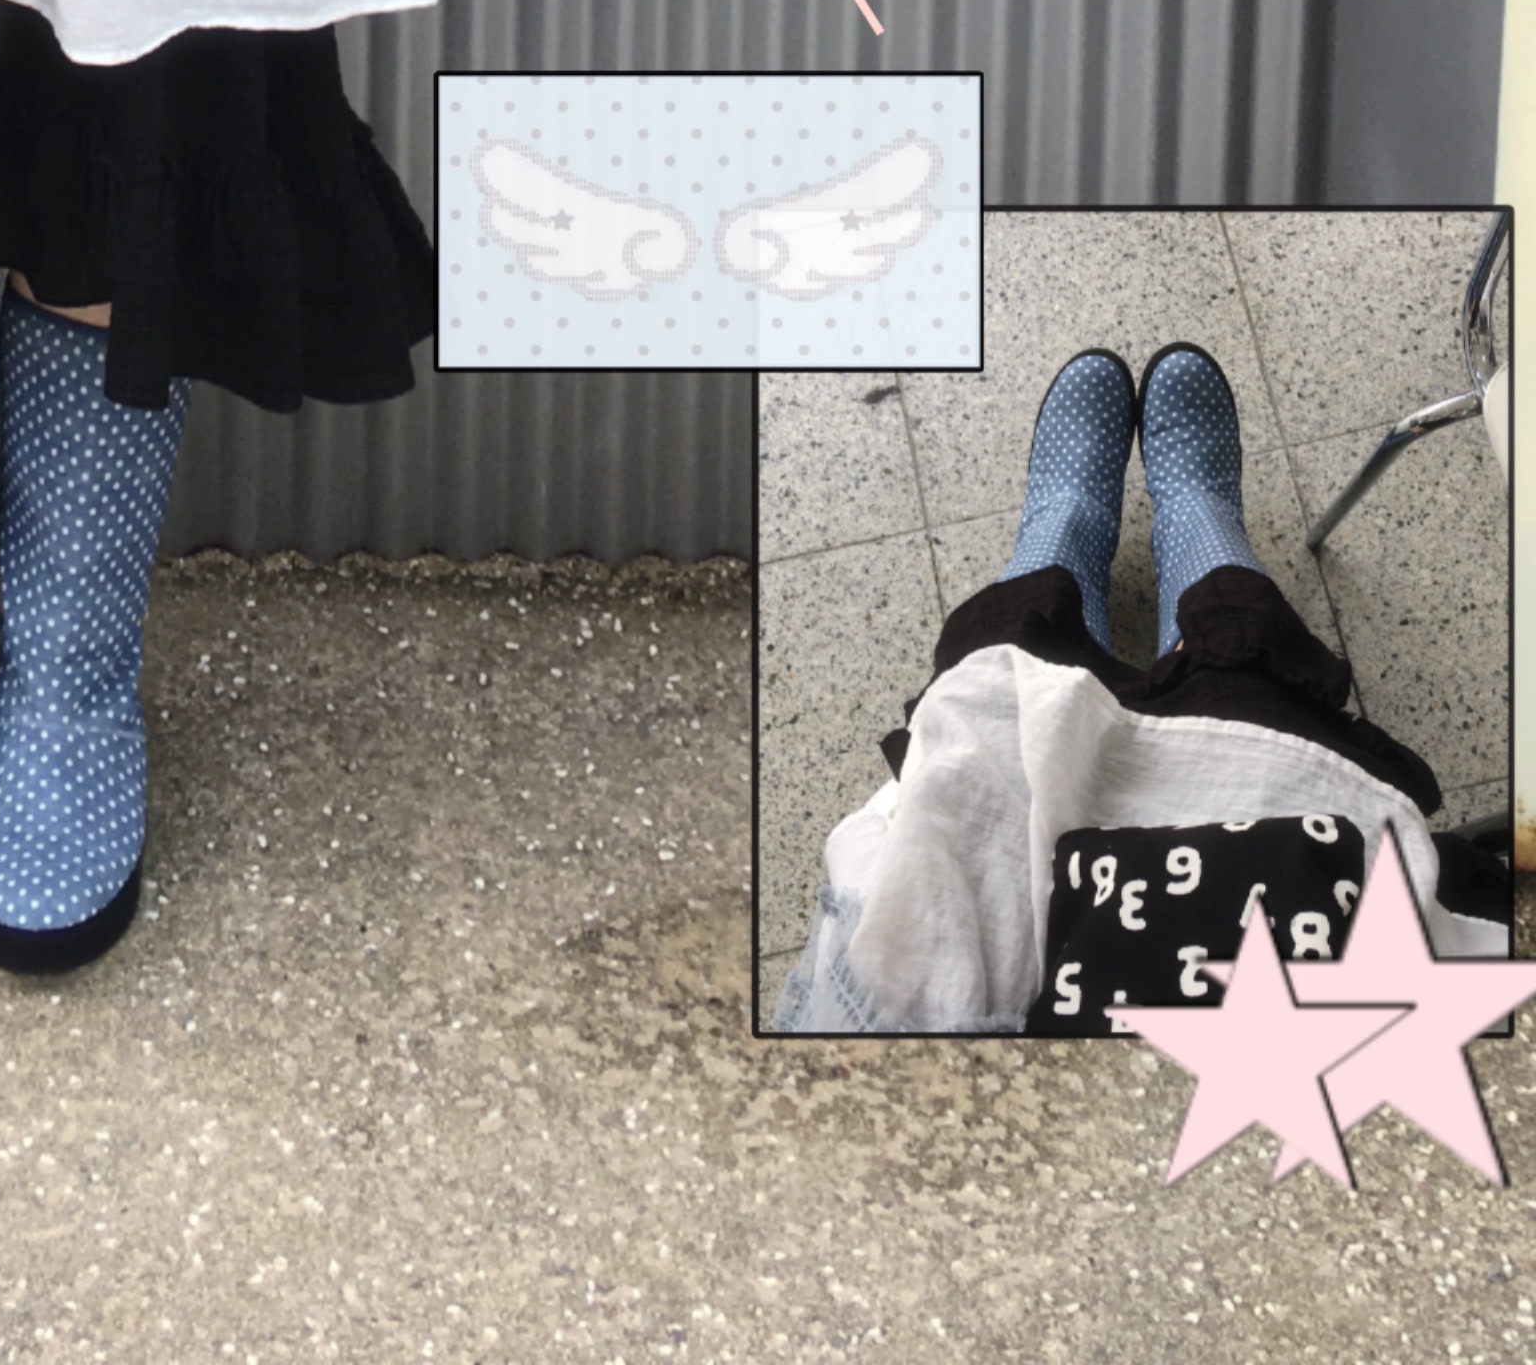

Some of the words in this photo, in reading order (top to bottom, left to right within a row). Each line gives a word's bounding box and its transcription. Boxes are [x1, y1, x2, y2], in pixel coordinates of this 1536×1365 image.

[1166, 845, 1202, 895] 6
[1118, 879, 1148, 931] 3
[1290, 911, 1332, 959] 8
[1053, 962, 1082, 1015] 5
